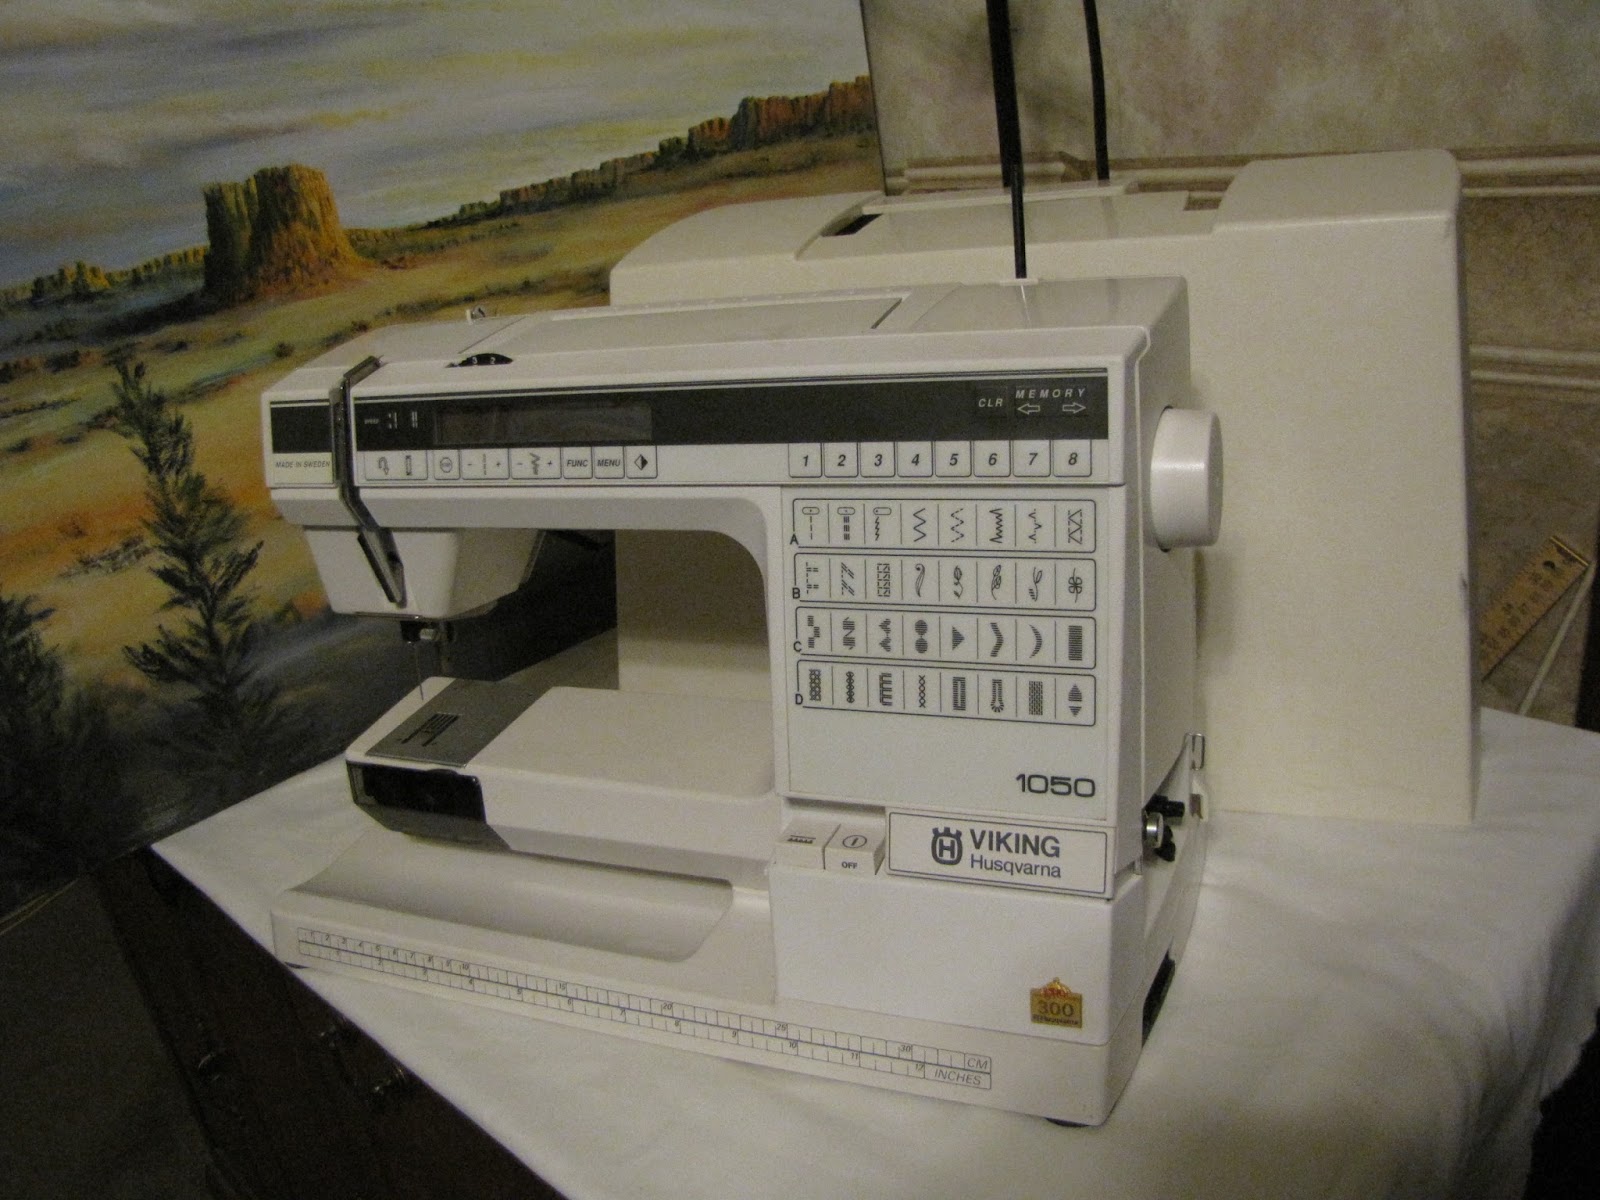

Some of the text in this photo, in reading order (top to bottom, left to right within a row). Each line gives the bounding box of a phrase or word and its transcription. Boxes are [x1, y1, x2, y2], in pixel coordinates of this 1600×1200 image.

[1015, 388, 1086, 399] MEMORY
[978, 398, 1003, 408] CLR
[276, 461, 294, 469] MADE
[303, 460, 331, 468] SWEDEN
[566, 459, 589, 468] FUNC
[597, 459, 621, 467] MENU
[802, 454, 809, 467] 1
[837, 454, 846, 467] 2
[874, 453, 883, 467] 3
[911, 453, 920, 466] 4
[949, 453, 959, 466] 5
[988, 452, 997, 466] 6
[1028, 452, 1038, 466] 7
[1068, 452, 1078, 466] 8
[790, 534, 799, 545] A
[792, 587, 801, 599] B
[793, 641, 802, 653] C
[795, 693, 804, 705] D
[1016, 773, 1096, 798] 1050
[970, 829, 1060, 858] VIKING
[841, 861, 858, 869] OFF
[970, 854, 1061, 878] Husqvarna
[1038, 1000, 1075, 1017] 300
[777, 1023, 787, 1031] 25
[901, 1045, 912, 1053] 30
[967, 1058, 988, 1071] CM
[851, 1052, 859, 1060] 11
[934, 1069, 982, 1087] INCHES
